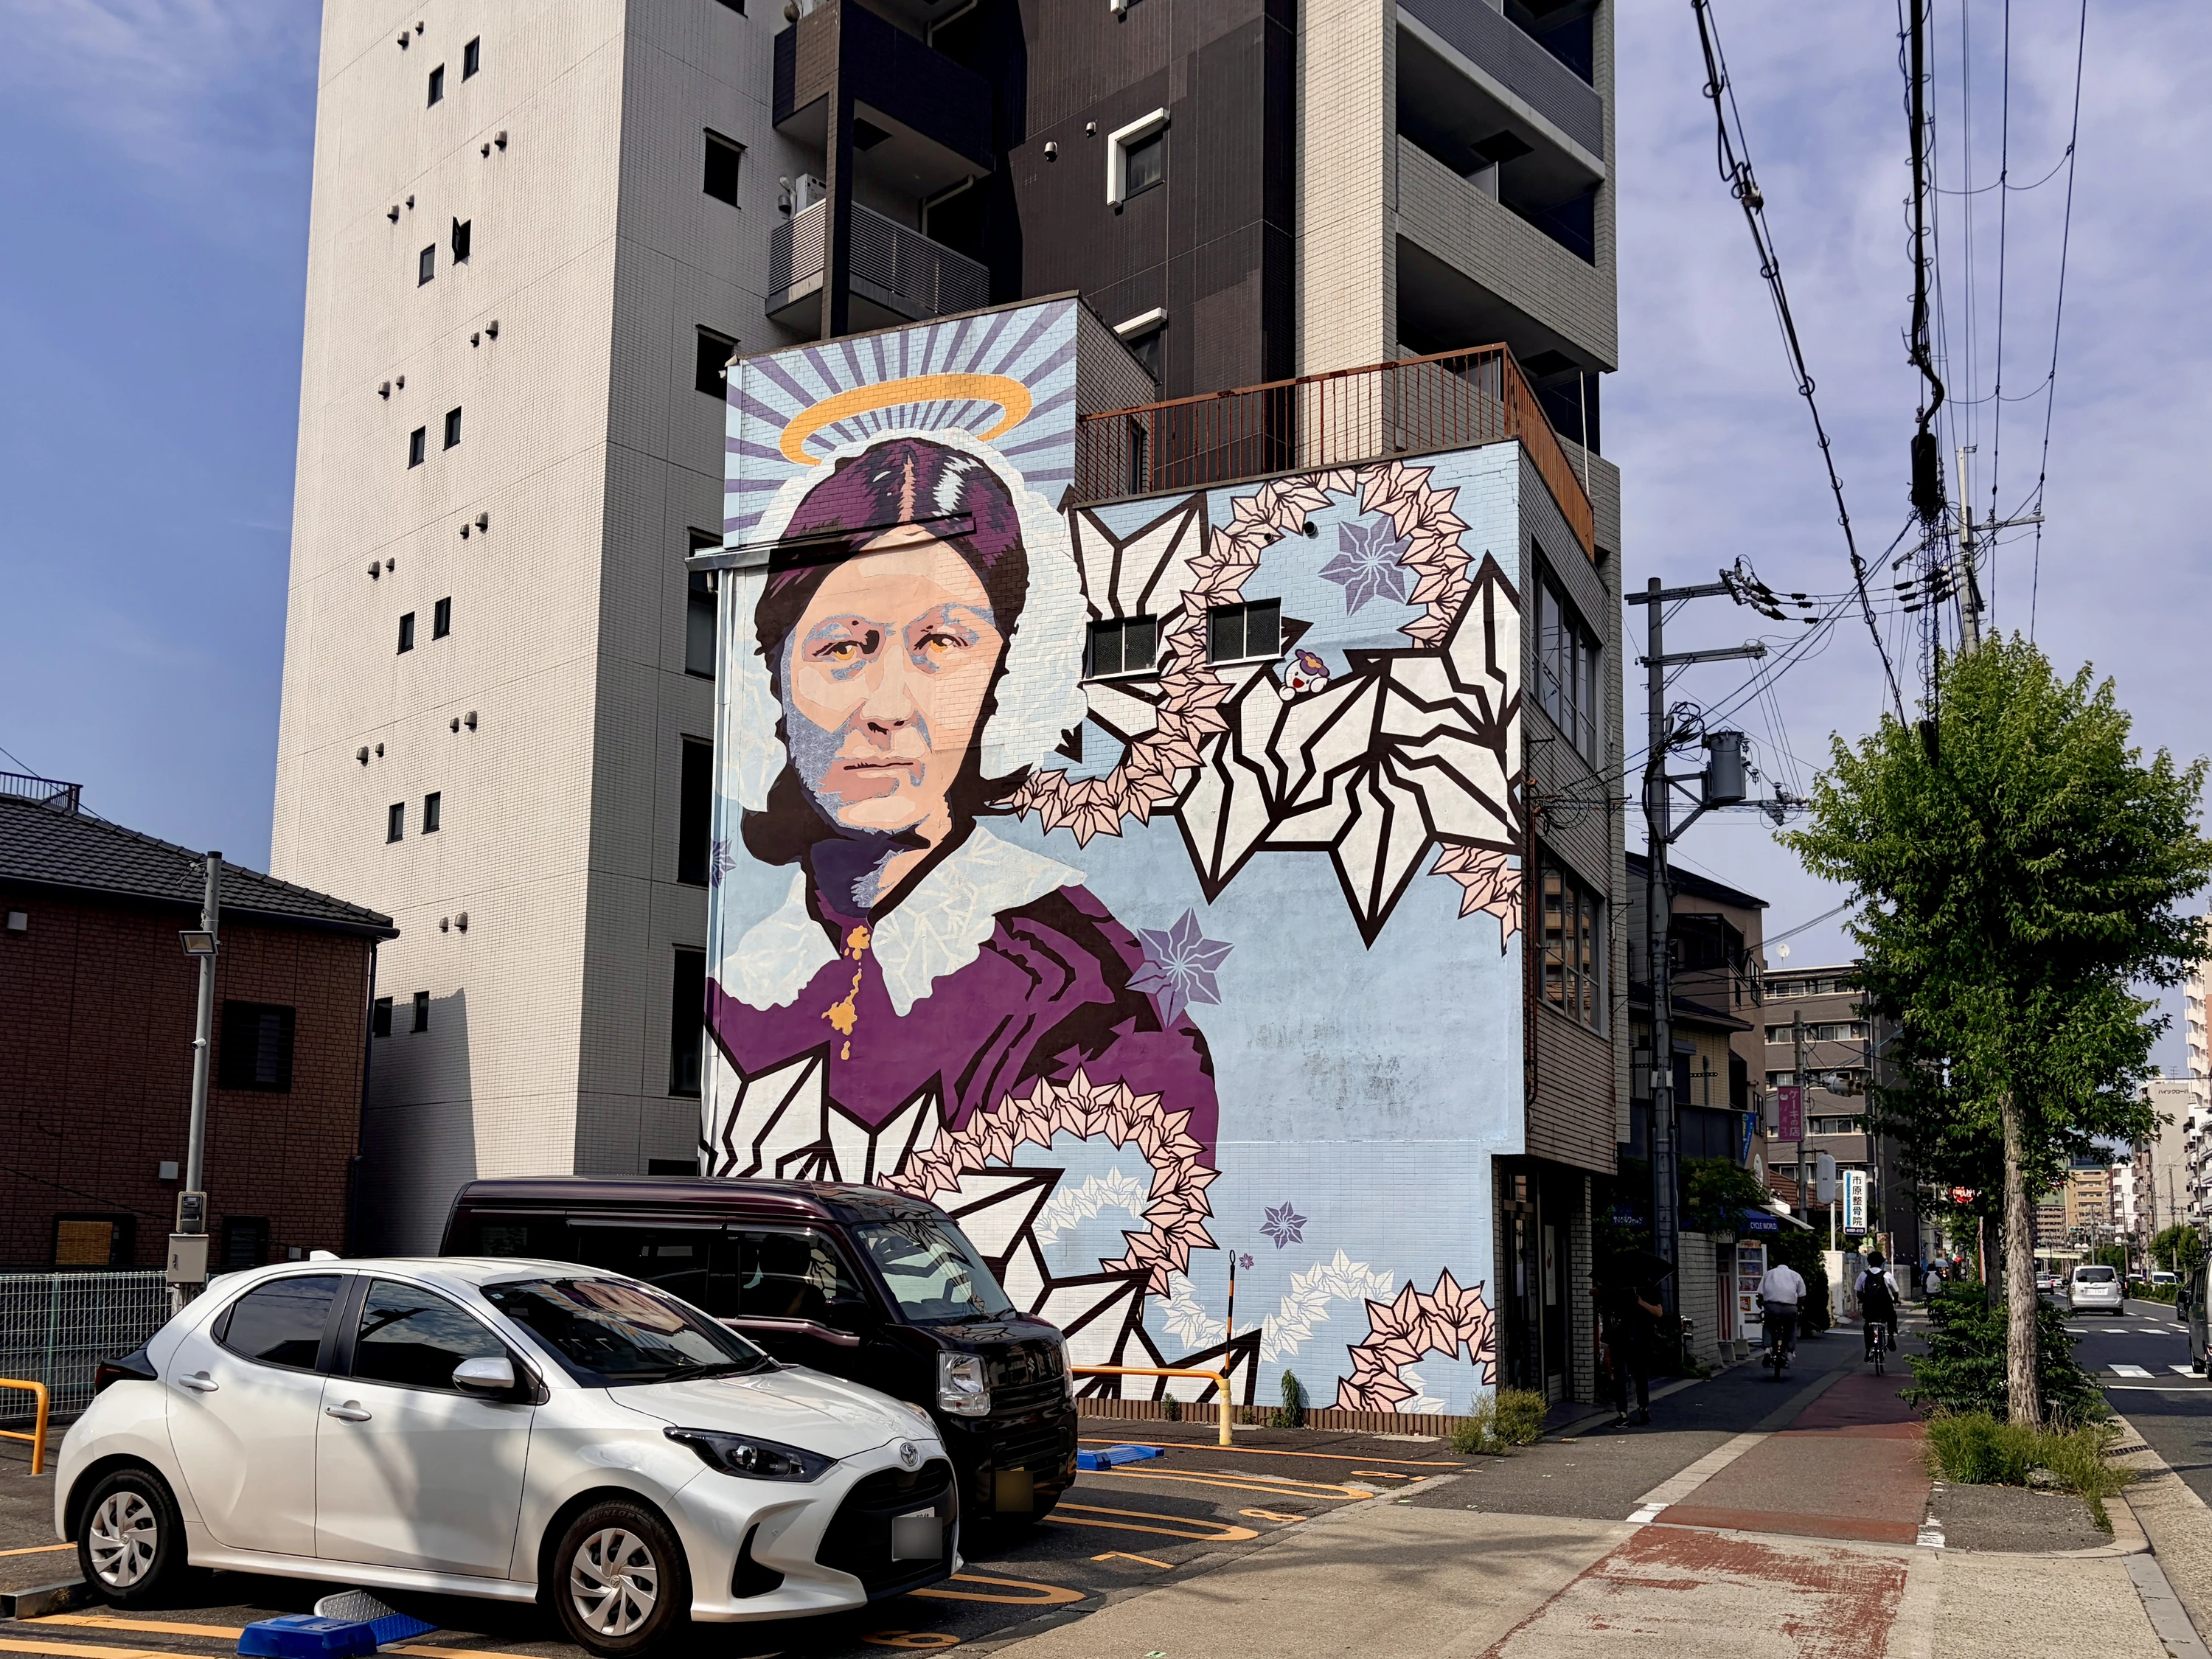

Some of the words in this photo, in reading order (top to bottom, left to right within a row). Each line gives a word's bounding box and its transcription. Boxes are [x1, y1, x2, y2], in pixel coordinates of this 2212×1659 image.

[1789, 1090, 1801, 1137] ケーキの店
[1852, 1175, 1863, 1226] 市原整骨院
[1750, 1222, 1762, 1230] CYCLE
[589, 1510, 635, 1521] DUNLOP
[1239, 1509, 1307, 1522] 8
[860, 1630, 961, 1648] 6
